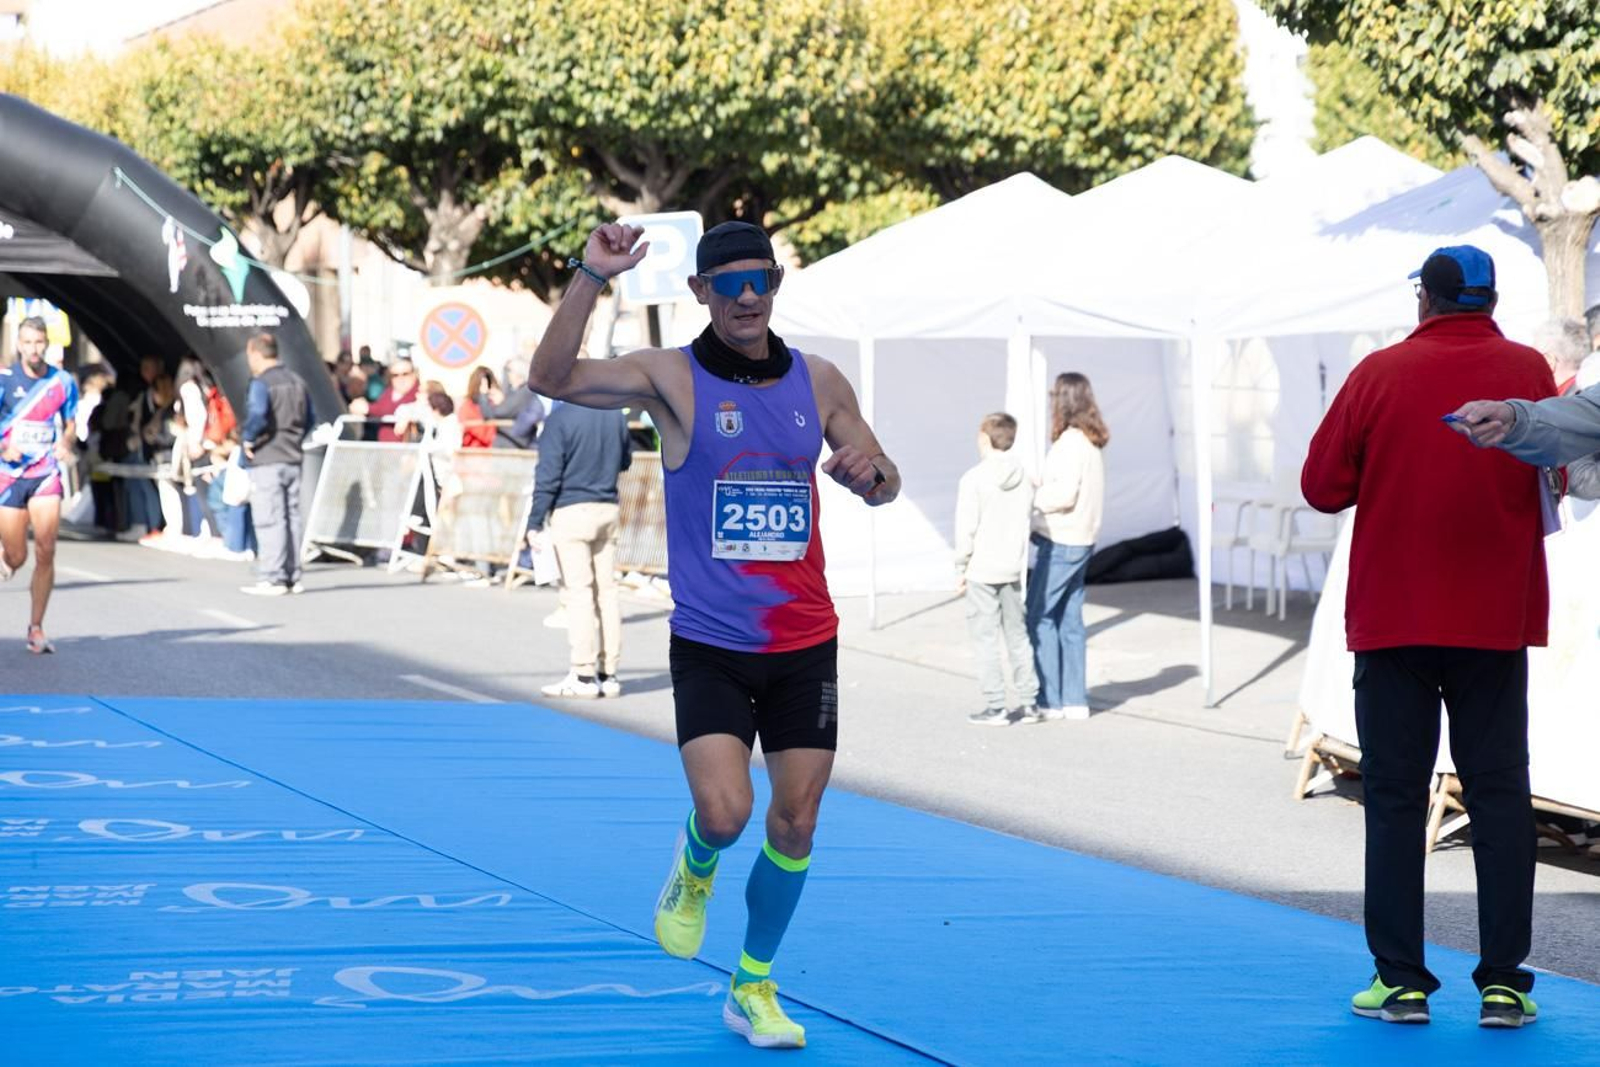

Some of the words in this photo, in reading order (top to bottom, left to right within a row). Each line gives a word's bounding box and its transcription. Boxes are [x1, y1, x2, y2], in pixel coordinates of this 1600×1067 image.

[722, 503, 806, 532] 2503
[749, 531, 785, 539] ALEJANDRO
[50, 989, 290, 1004] MEDIA
